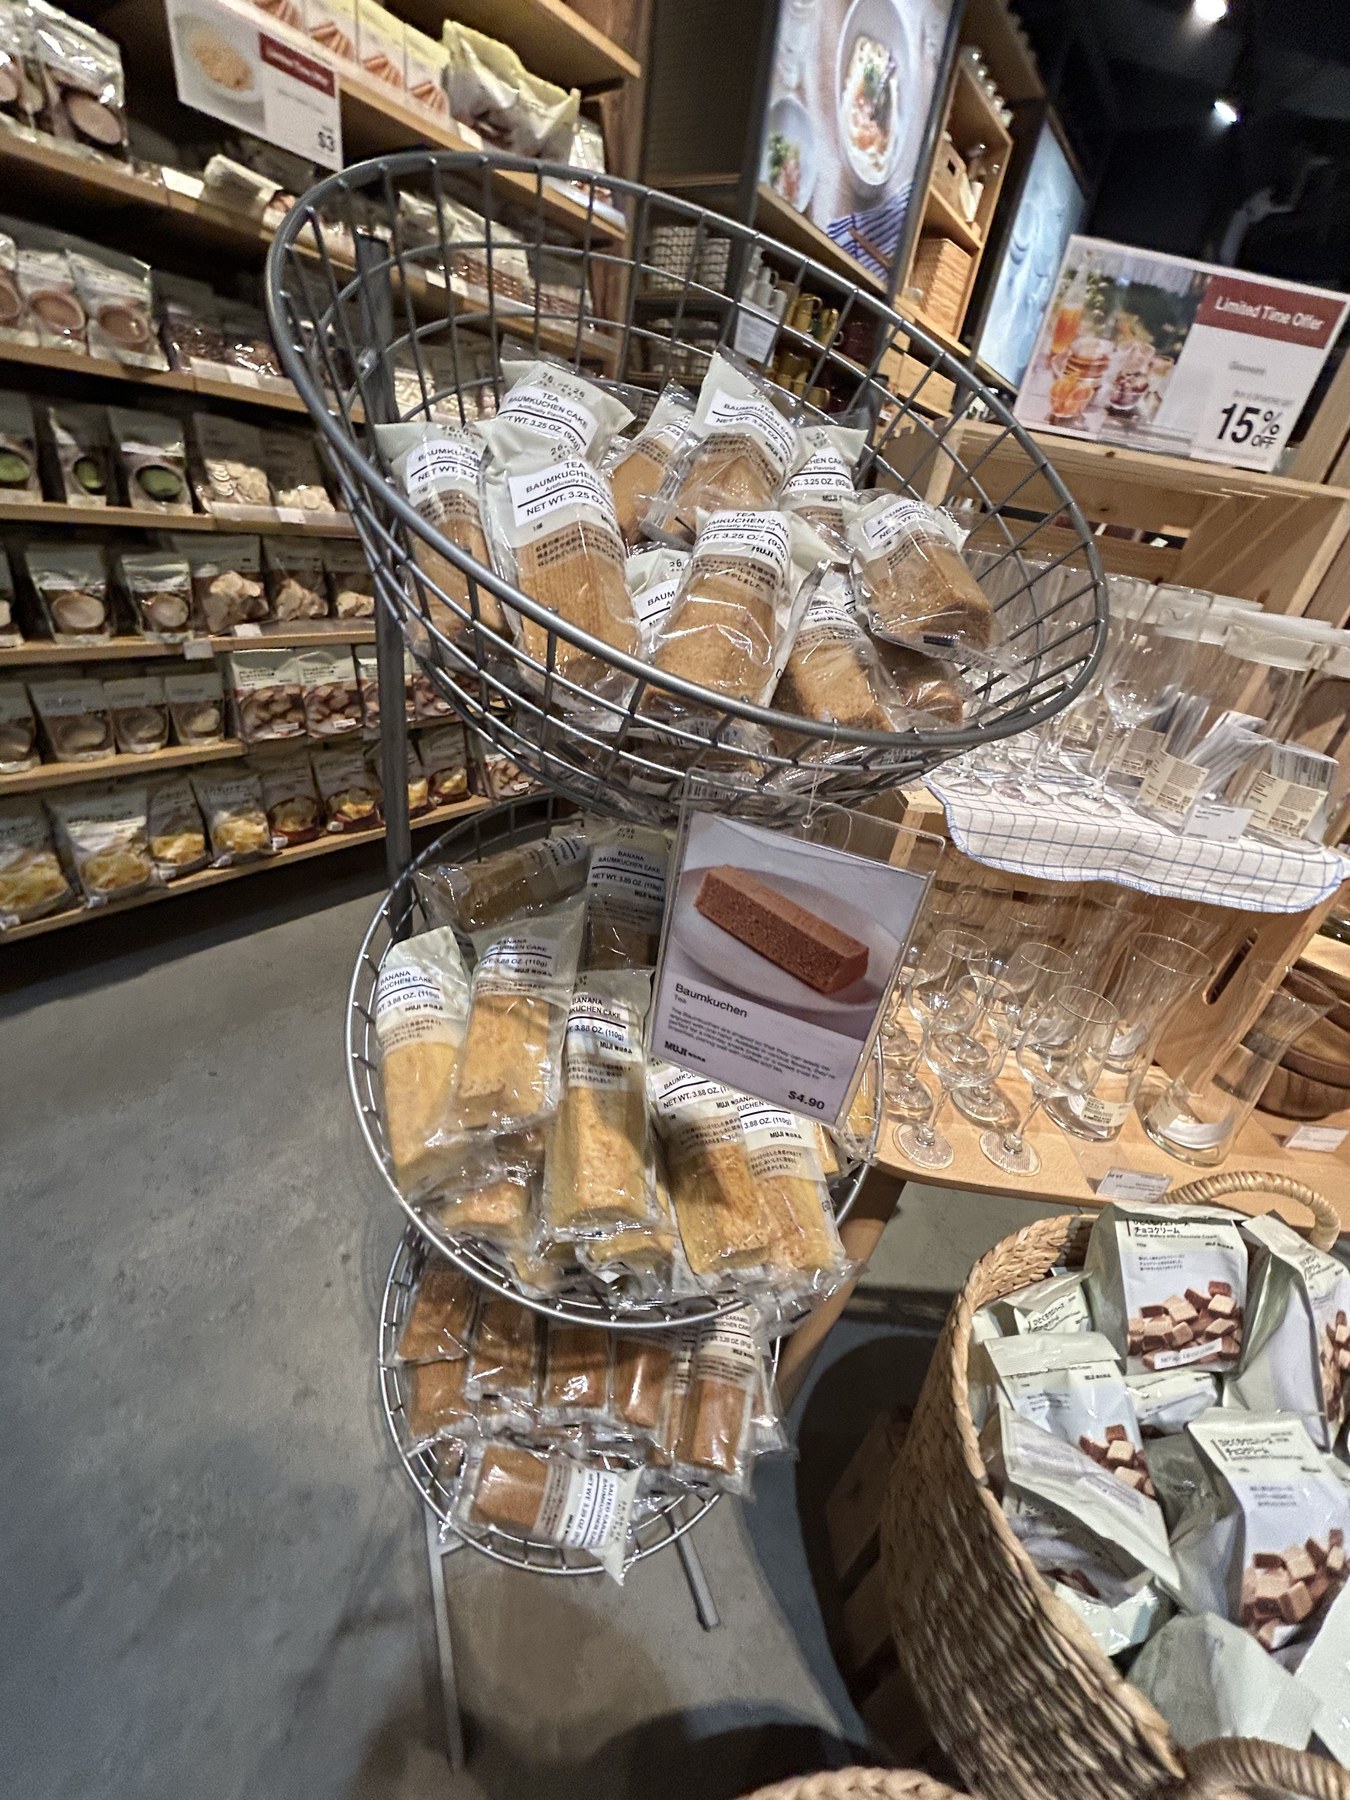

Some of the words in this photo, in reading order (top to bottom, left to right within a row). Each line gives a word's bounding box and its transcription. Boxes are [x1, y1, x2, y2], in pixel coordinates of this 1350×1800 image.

[317, 131, 335, 152] $3
[1214, 296, 1260, 318] Limited
[1262, 306, 1291, 324] Time
[1292, 312, 1326, 330] Offer
[542, 392, 559, 402] TEA
[508, 396, 565, 413] BAUMKUCHEN
[566, 409, 588, 429] CAKE
[514, 416, 528, 425] WT.
[529, 420, 547, 429] 3.25
[548, 424, 562, 433] OZ.
[1251, 435, 1277, 448] OFF
[565, 461, 585, 470] TEA
[418, 468, 437, 482] NET
[526, 470, 596, 493] BAUMKUCHEN
[526, 502, 546, 516] NET
[548, 495, 567, 506] WT.
[568, 491, 590, 499] 3.25
[702, 533, 719, 542] WT.
[752, 545, 774, 558] MUJI
[618, 851, 644, 861] BANANA
[598, 857, 643, 869] BAUMKUCHEN
[412, 976, 433, 984] CAKE
[402, 992, 416, 1000] OZ.
[674, 994, 687, 1004] Tea
[676, 983, 747, 1018] Baumkuchen
[603, 1009, 621, 1019] CAKE
[591, 1026, 603, 1034] OZ.
[605, 1029, 625, 1042] (110g)
[600, 1041, 613, 1050] MUJI
[665, 1041, 687, 1057] MUJI
[664, 1097, 677, 1108] NET
[678, 1093, 692, 1102] WT.
[693, 1090, 706, 1098] 3.88
[788, 1091, 825, 1110] $4.90
[744, 1121, 758, 1129] 3.88
[773, 1117, 792, 1126] (110g)
[605, 1483, 614, 1512] SALTED
